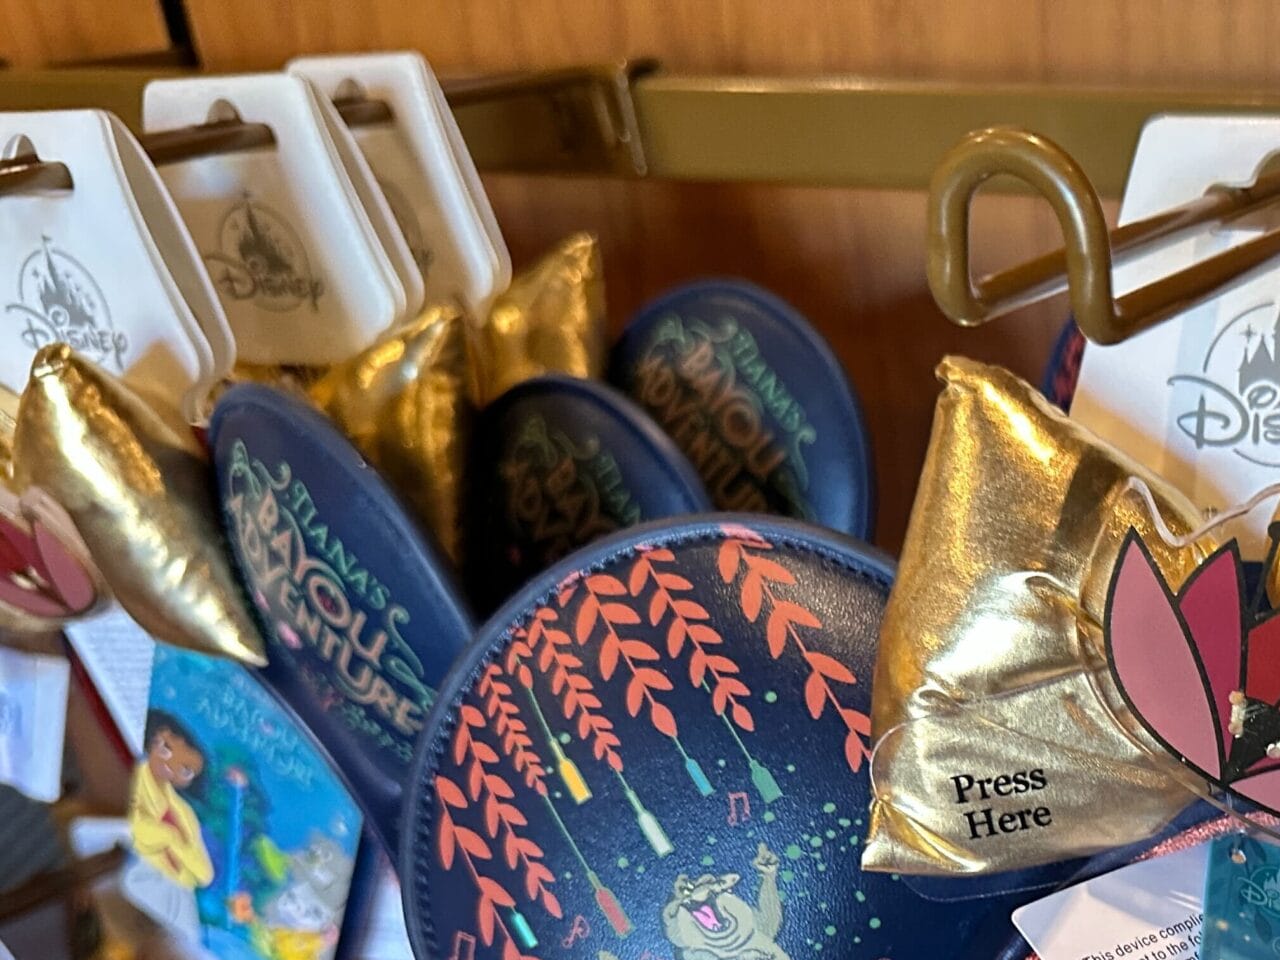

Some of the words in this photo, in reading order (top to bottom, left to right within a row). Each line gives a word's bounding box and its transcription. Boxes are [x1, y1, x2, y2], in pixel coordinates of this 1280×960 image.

[950, 768, 1048, 804] Press
[963, 805, 1053, 840] Here
[1115, 933, 1158, 958] device
[1166, 941, 1189, 957] the
